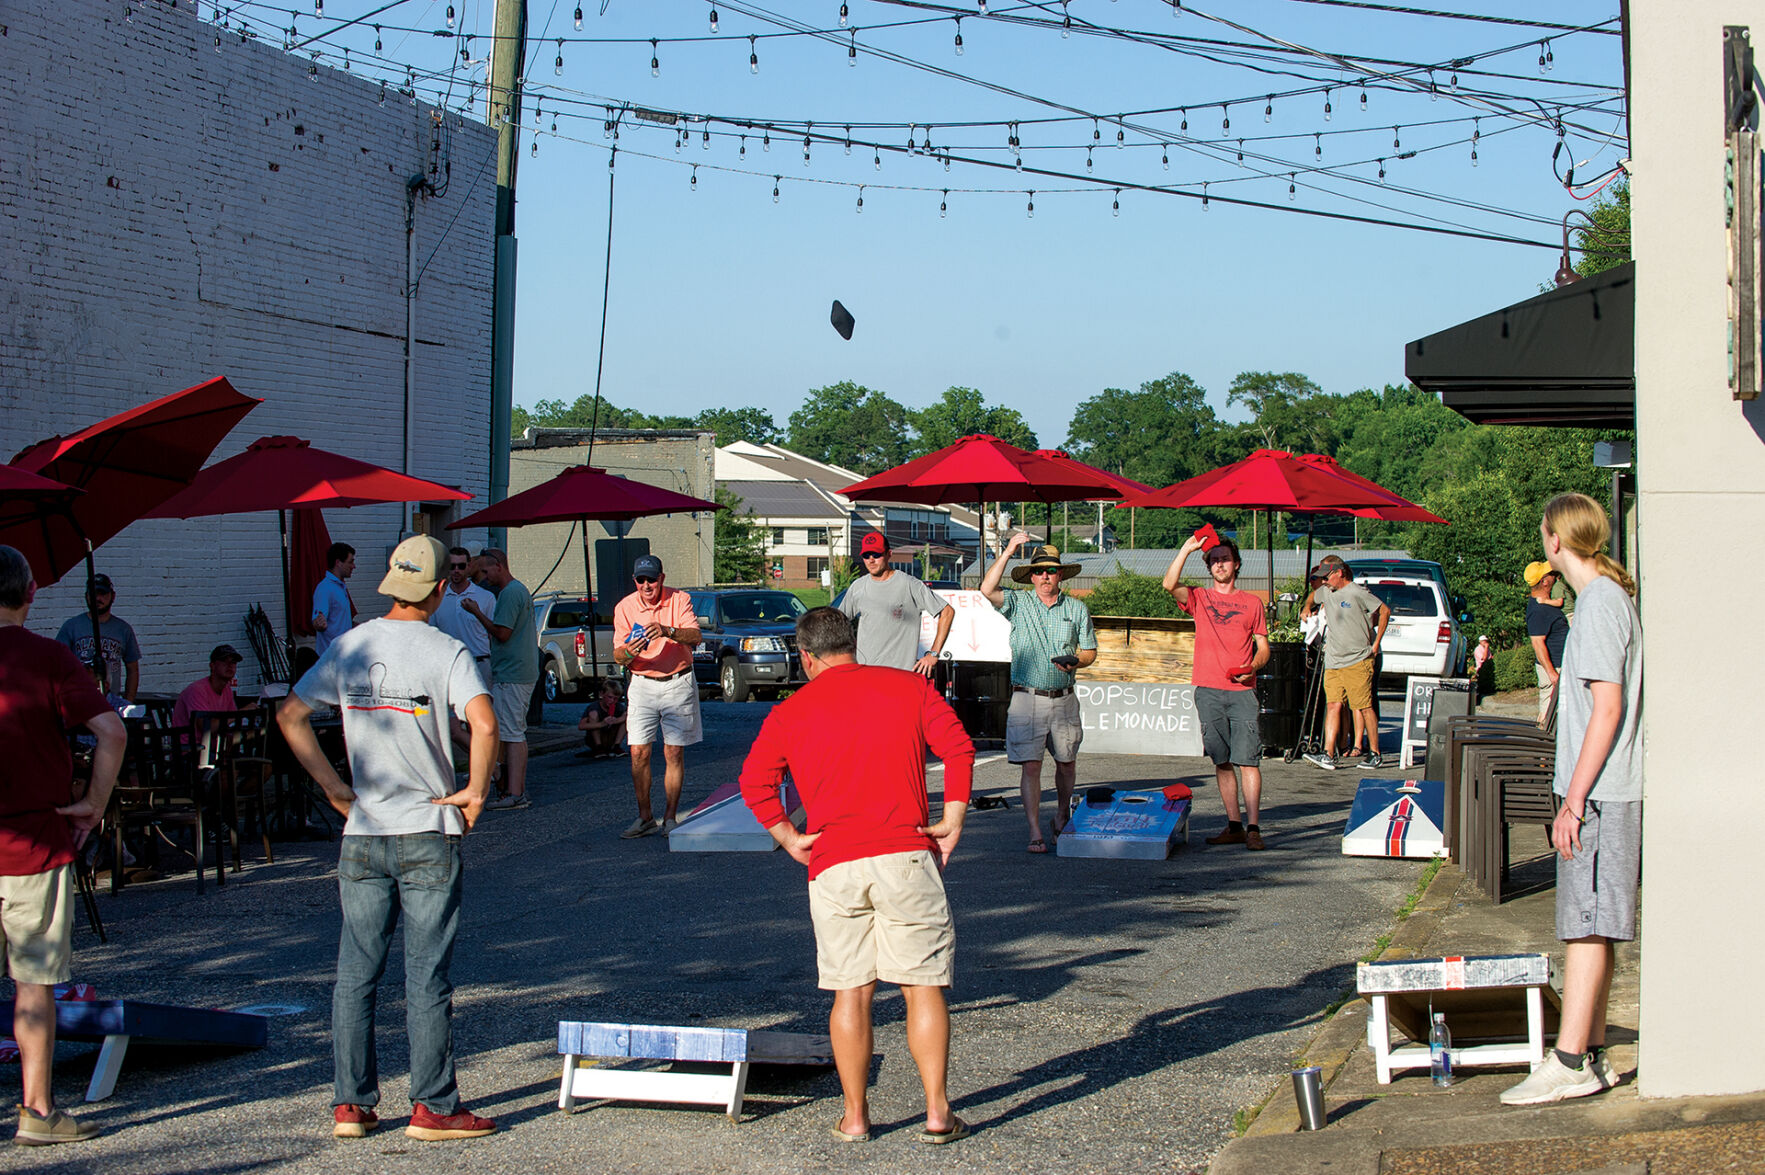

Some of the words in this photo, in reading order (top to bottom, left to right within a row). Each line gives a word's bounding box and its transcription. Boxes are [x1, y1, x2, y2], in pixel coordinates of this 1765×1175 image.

[75, 637, 121, 656] ALAAMA
[1076, 684, 1194, 710] POPSICLES
[1081, 711, 1191, 732] LEMONADE
